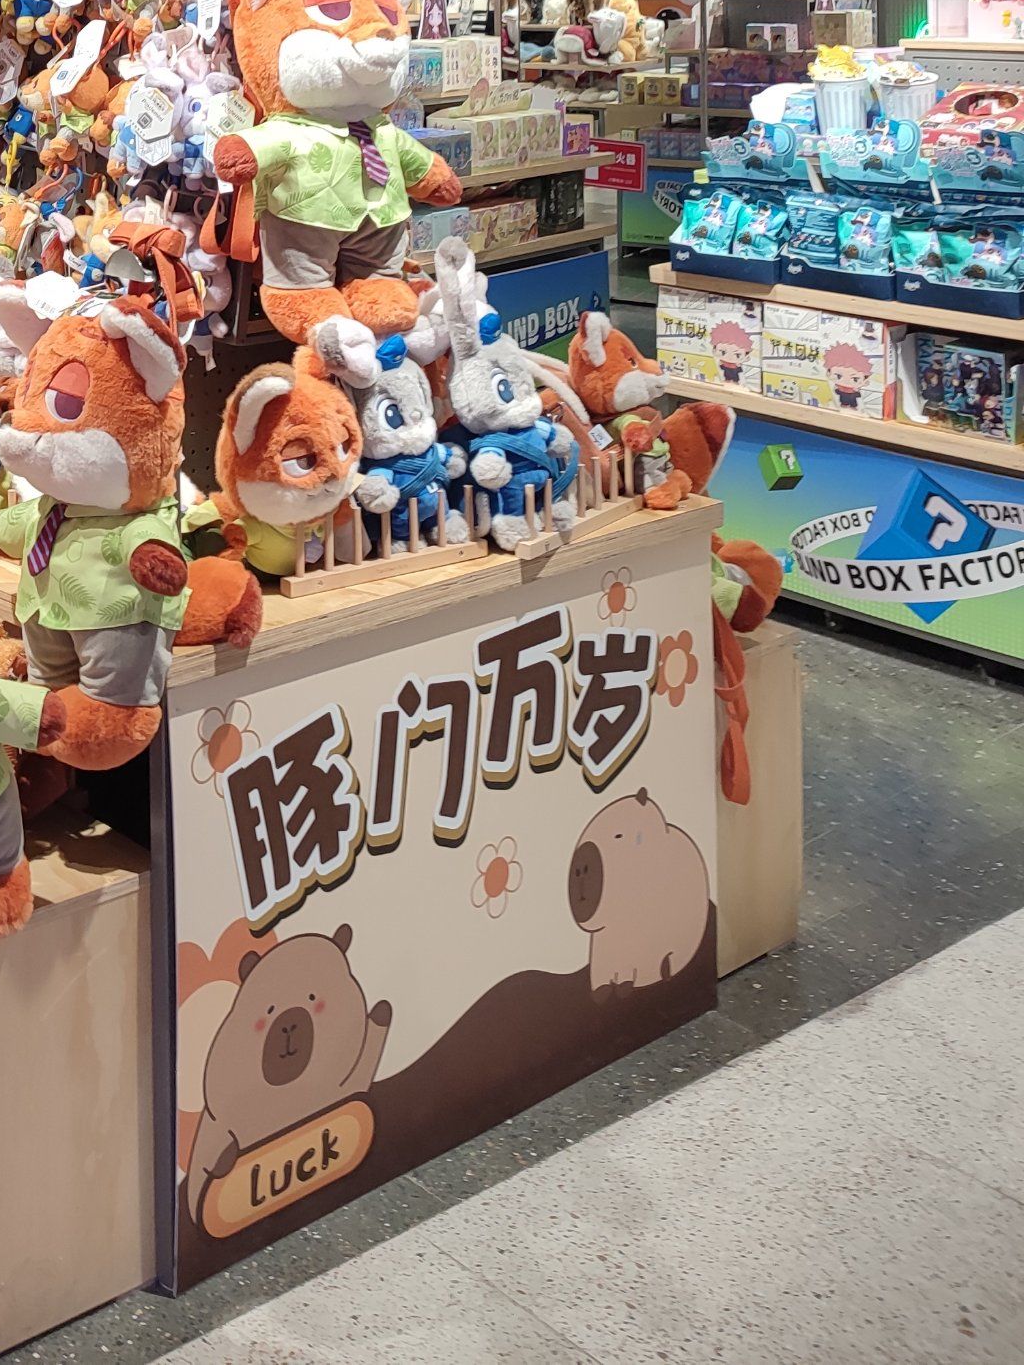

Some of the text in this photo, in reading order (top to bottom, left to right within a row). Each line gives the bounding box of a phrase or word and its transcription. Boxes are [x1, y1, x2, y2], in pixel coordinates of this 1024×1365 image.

[544, 296, 580, 340] BOX
[793, 550, 841, 585] BLIND
[845, 563, 912, 592] BOX
[224, 605, 657, 924] 豚门万岁
